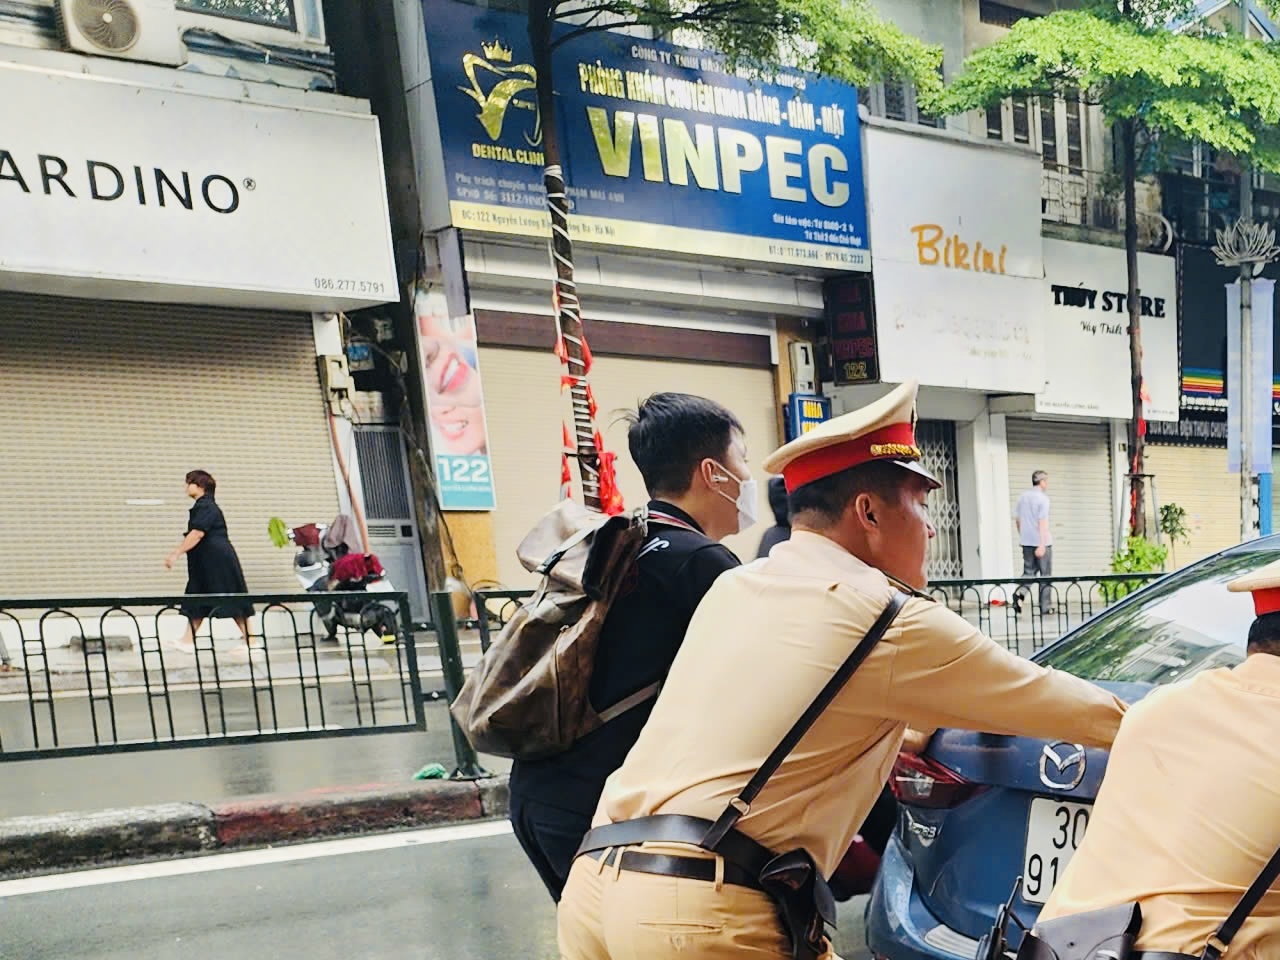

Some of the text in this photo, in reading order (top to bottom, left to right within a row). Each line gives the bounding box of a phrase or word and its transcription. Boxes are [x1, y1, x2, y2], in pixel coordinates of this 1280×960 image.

[578, 60, 625, 99] PHÒNG
[626, 69, 665, 105] KHÁM
[666, 77, 715, 114] CHUYÊN
[746, 88, 781, 126] RĂNG
[472, 143, 516, 163] DENTAL
[586, 106, 850, 208] VINPEC
[910, 224, 1007, 274] Bikini
[1102, 291, 1166, 318] STRE
[438, 458, 489, 482] 122
